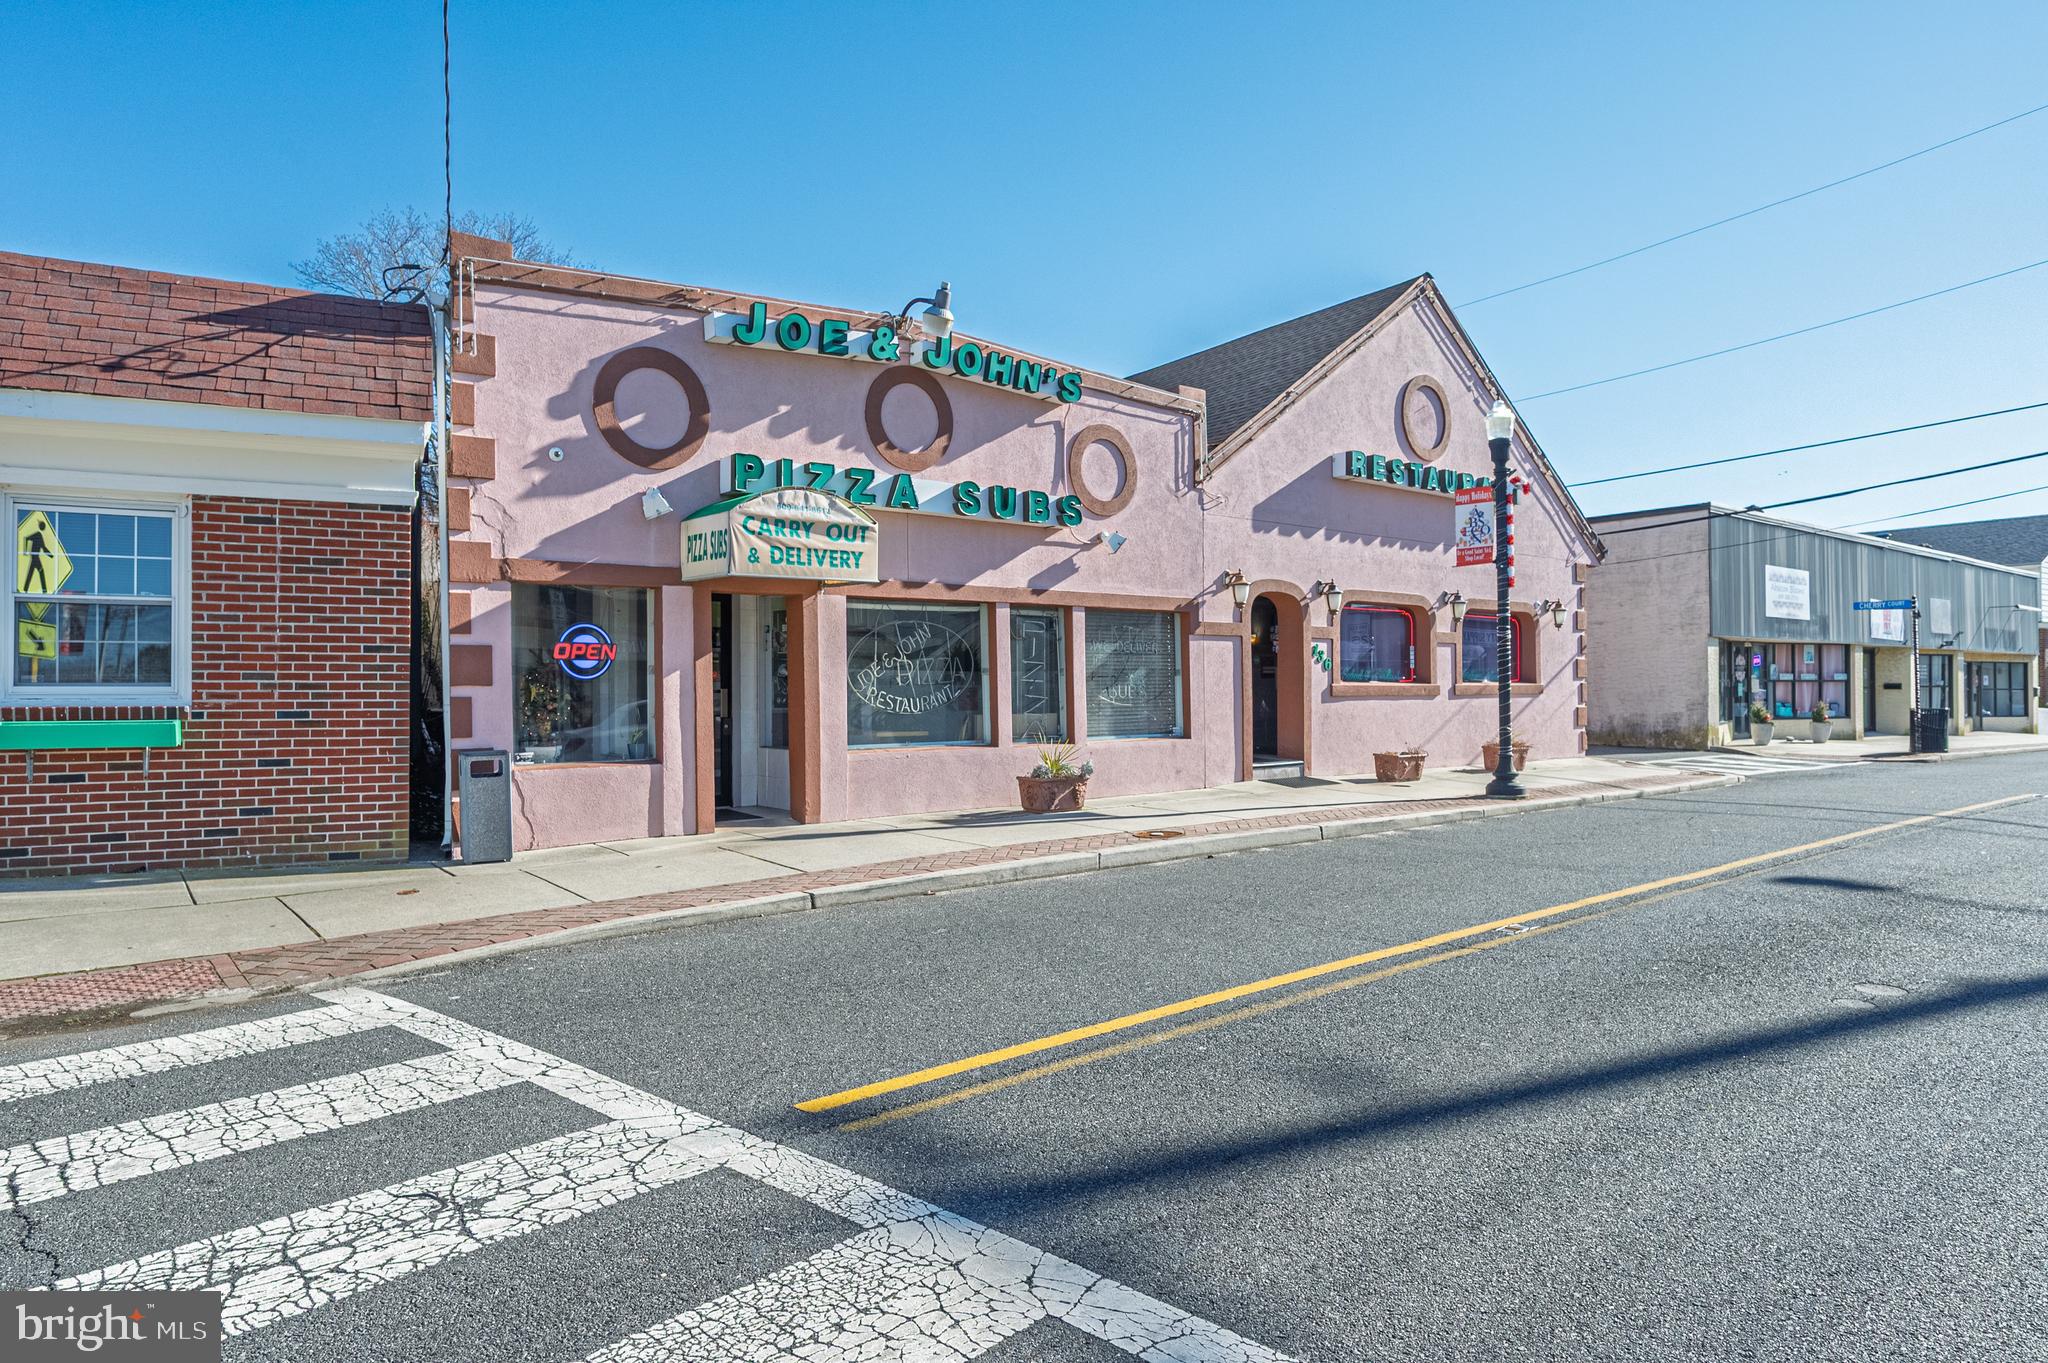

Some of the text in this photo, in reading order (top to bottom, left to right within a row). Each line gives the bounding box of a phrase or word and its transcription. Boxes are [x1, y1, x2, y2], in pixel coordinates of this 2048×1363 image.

[732, 302, 1083, 403] JOE & JOHN'S
[1346, 450, 1493, 494] RESTAUR
[731, 453, 1083, 527] PIZZA SUBS
[742, 515, 870, 544] CARRY OUT
[687, 528, 728, 563] PIZZA SUBS
[747, 545, 864, 569] & DELIVERY
[553, 642, 617, 661] OPEN
[1312, 643, 1332, 671] 186
[866, 684, 953, 713] RESTAURANT
